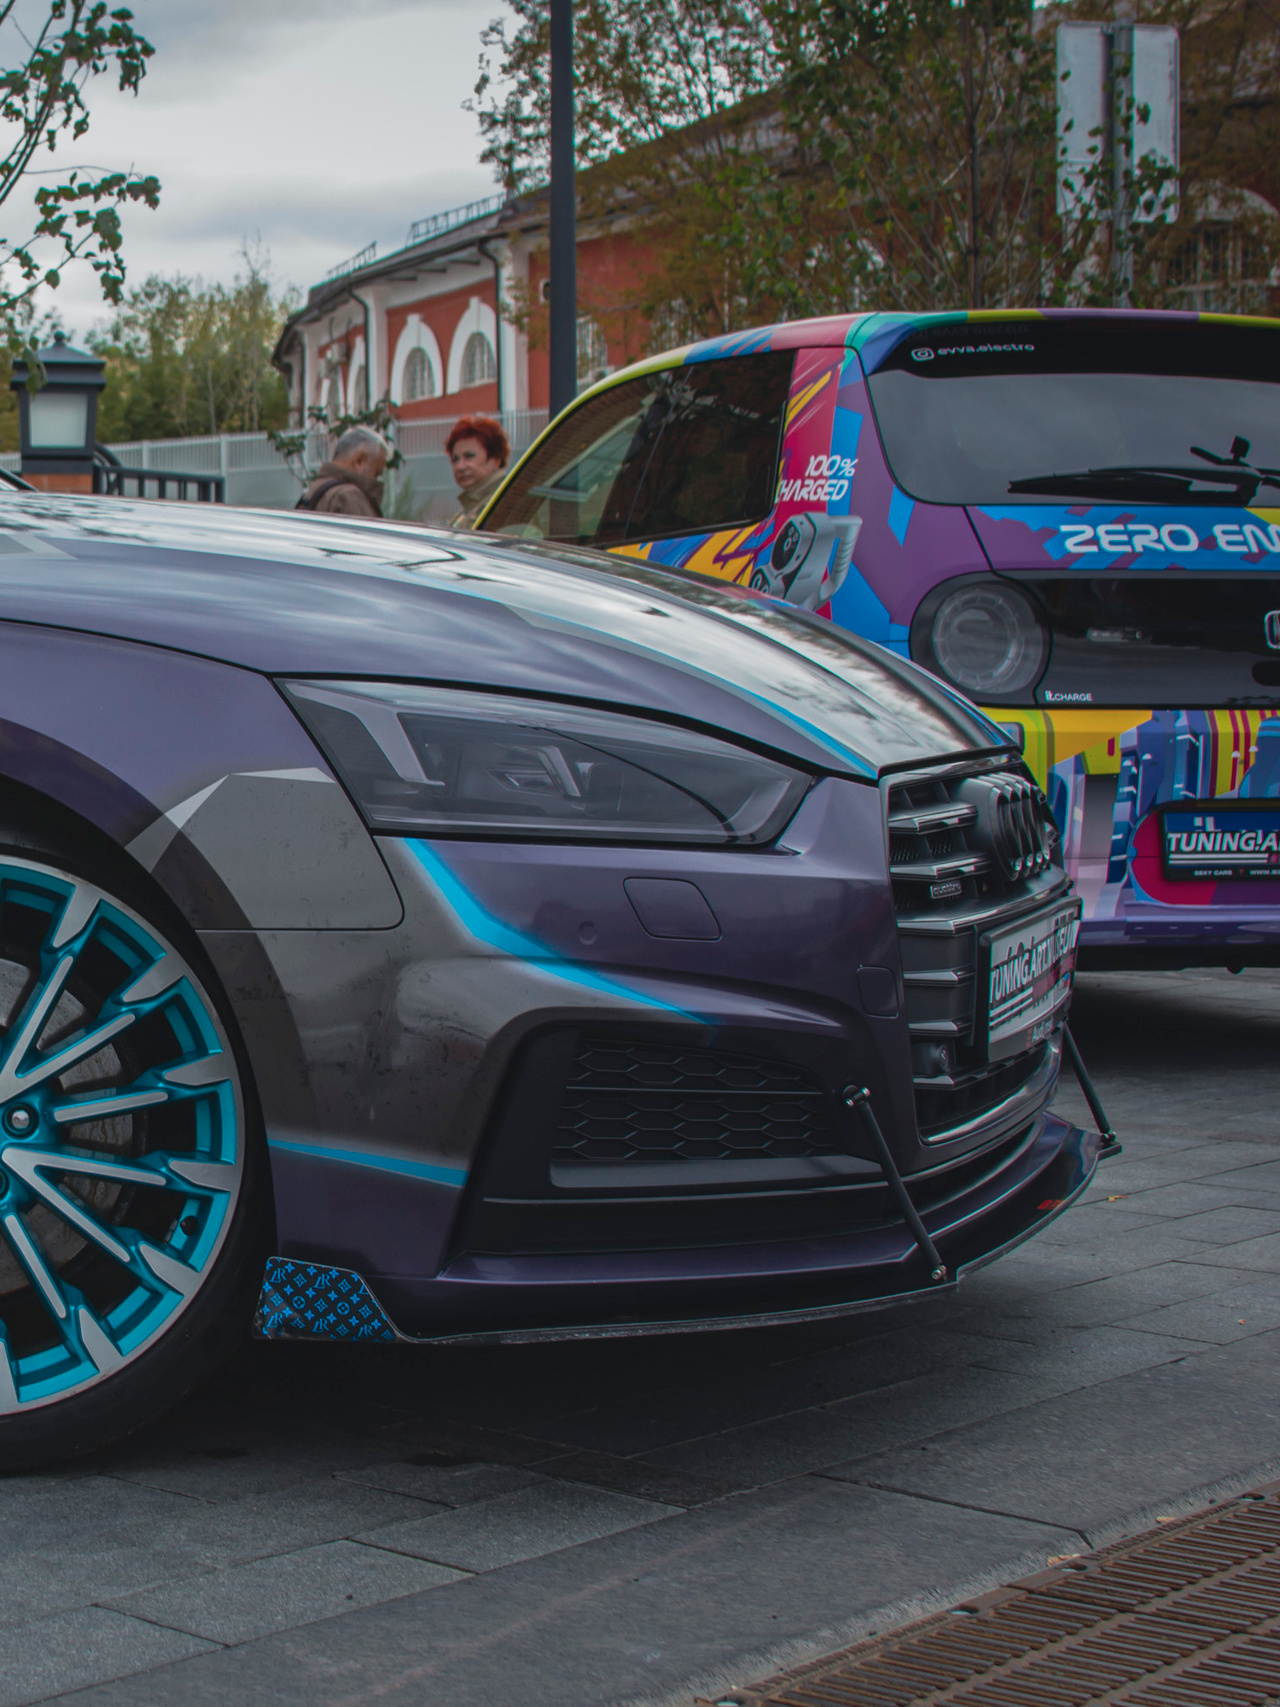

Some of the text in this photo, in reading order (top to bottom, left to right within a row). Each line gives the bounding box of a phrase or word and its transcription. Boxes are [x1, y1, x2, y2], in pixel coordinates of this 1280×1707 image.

[804, 454, 858, 477] 100%
[775, 479, 849, 502] HARGED
[1059, 523, 1199, 554] ZERO
[1167, 831, 1280, 853] TUNING.A
